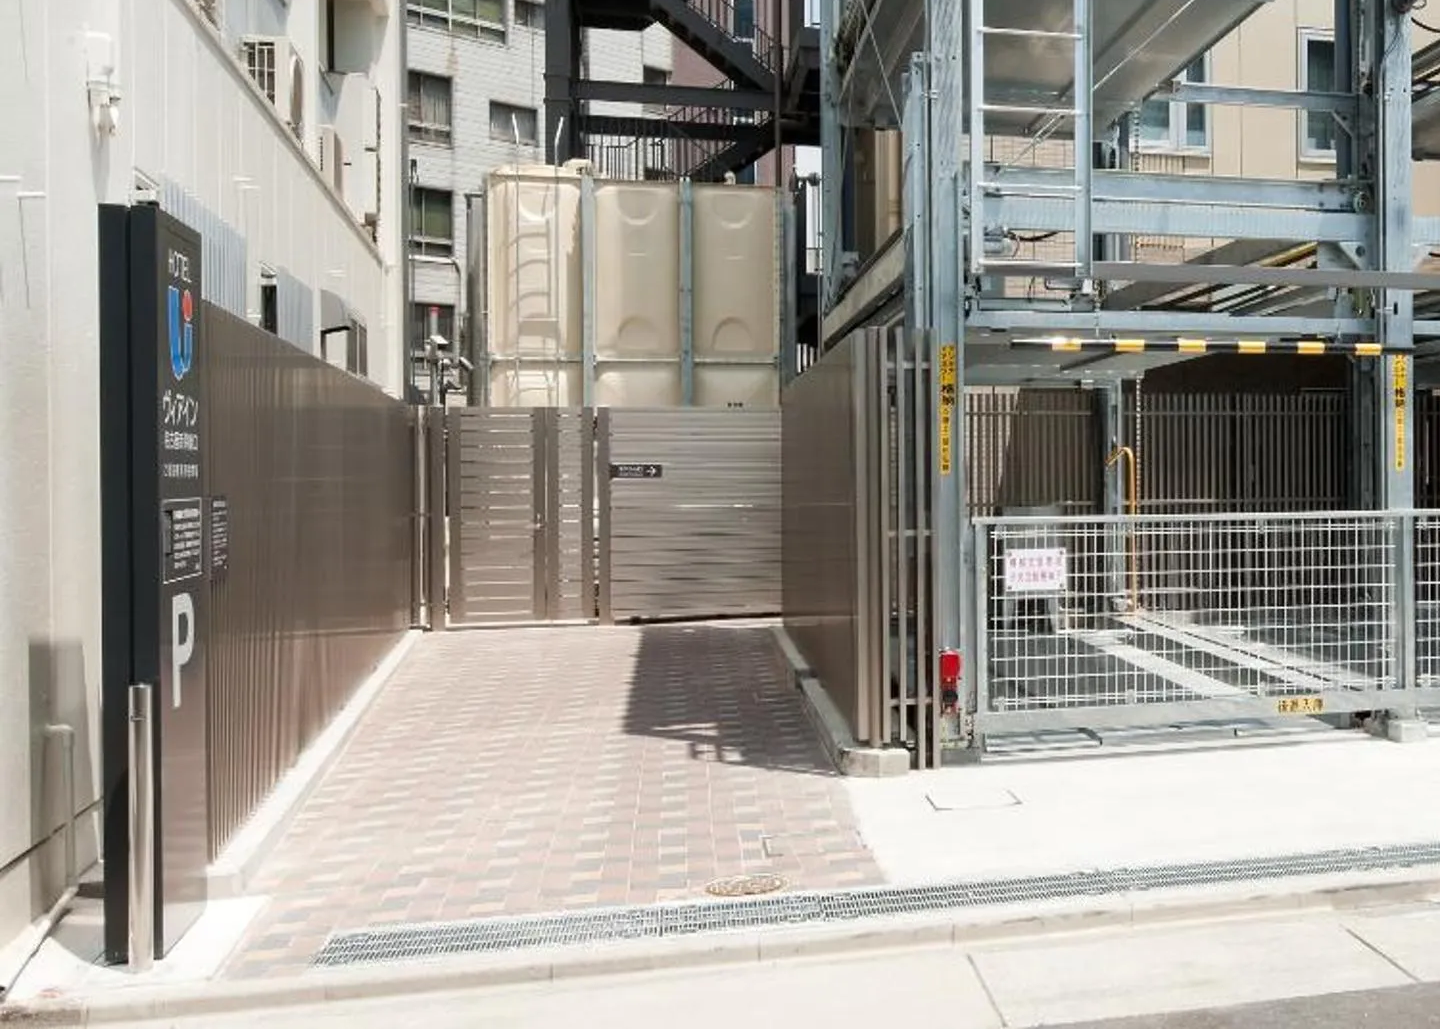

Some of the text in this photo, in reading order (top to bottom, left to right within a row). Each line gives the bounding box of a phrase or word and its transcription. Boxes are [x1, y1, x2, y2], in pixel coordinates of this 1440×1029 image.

[168, 248, 192, 283] HOTEL
[162, 389, 199, 428] ヴィアイン
[172, 592, 194, 708] P
